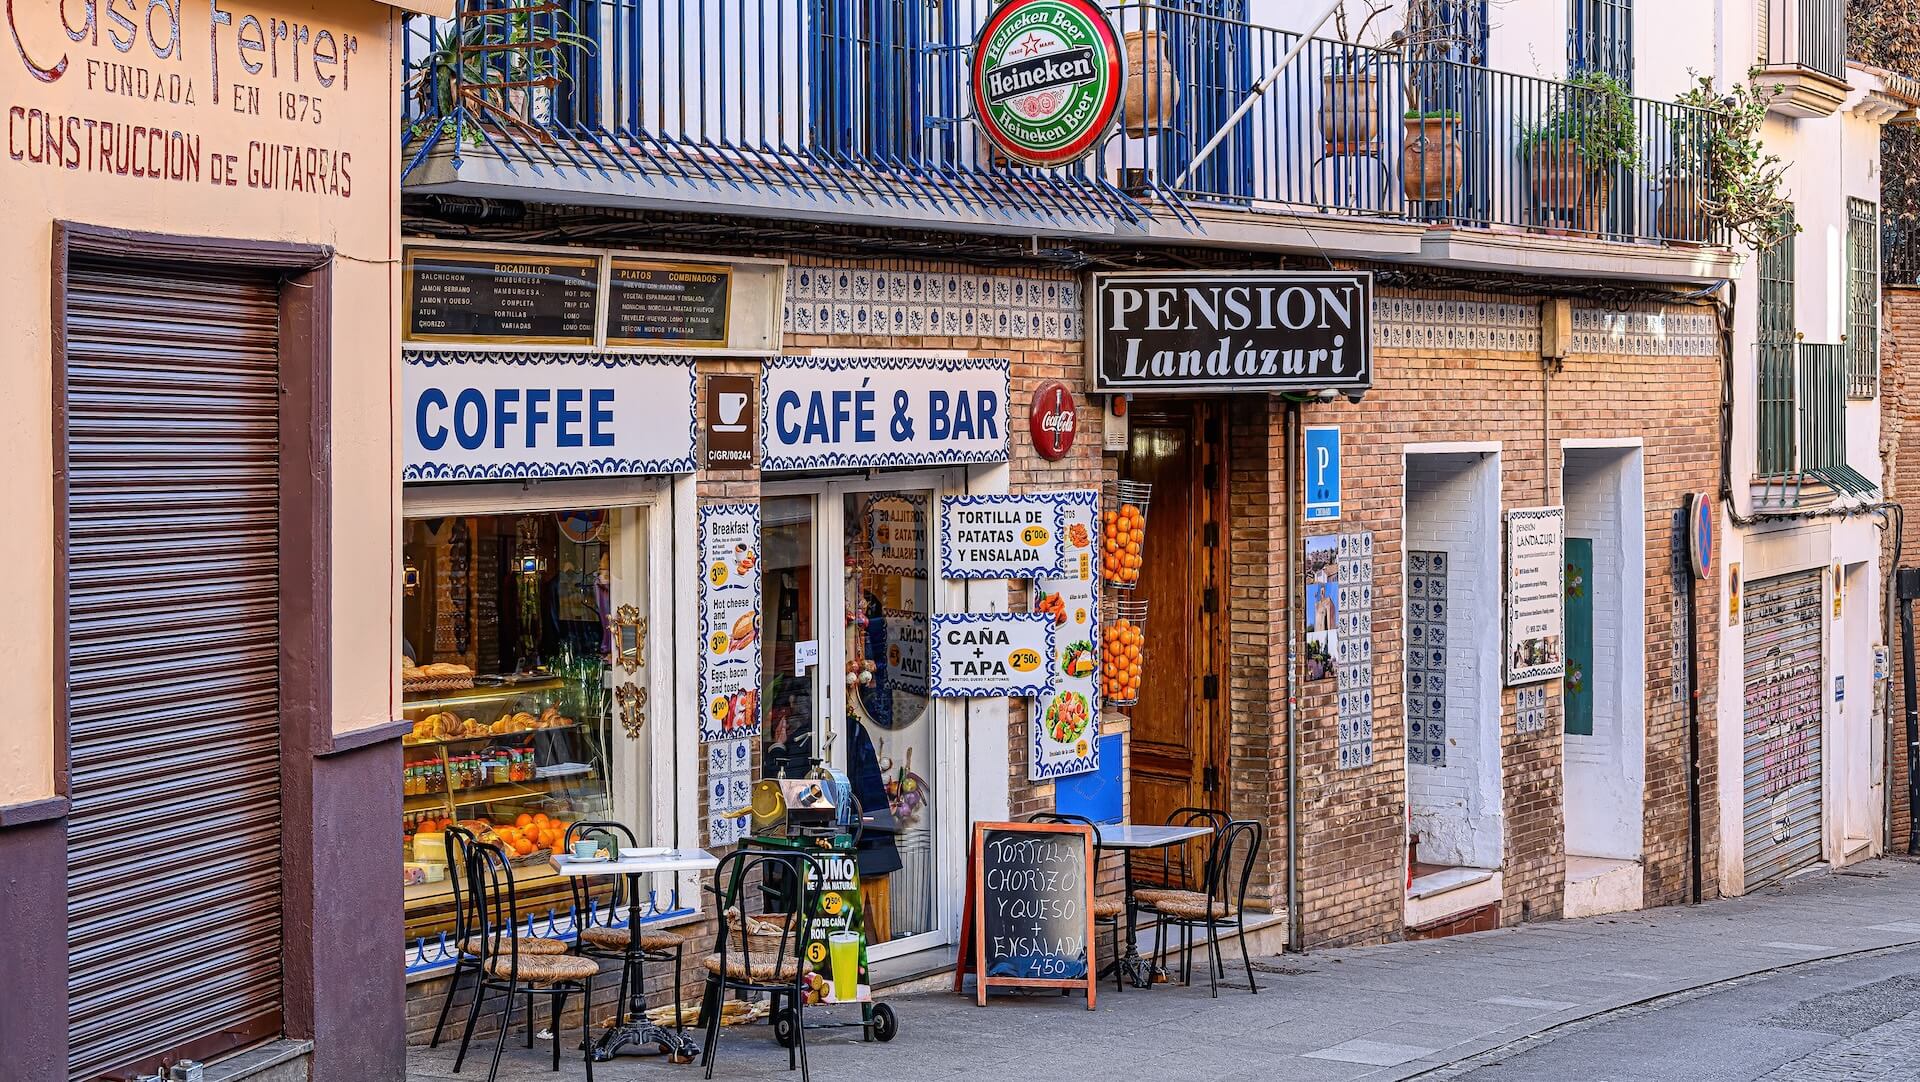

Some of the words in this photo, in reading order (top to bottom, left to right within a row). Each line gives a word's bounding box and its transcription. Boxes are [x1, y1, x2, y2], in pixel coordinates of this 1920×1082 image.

[988, 11, 1049, 60] Heineken
[1051, 10, 1085, 41] Beer
[989, 58, 1091, 98] Heineken
[86, 58, 196, 106] FUNDADA
[234, 84, 260, 116] EN
[278, 91, 323, 125] 1875
[999, 110, 1067, 142] Heineken
[1061, 90, 1093, 131] Beer
[9, 105, 200, 183] CONSTRUCCION
[248, 140, 352, 198] GUITARRAS
[494, 264, 551, 275] BOCADILLOS
[621, 270, 652, 280] PLATOS
[668, 273, 717, 283] COMBINADOS
[501, 299, 535, 307] COMPLETA
[1108, 286, 1354, 331] PENSION
[419, 308, 436, 316] ATUN
[494, 310, 527, 319] TORTILLAS
[564, 312, 580, 320] LOMO
[418, 320, 446, 328] CHORIZO
[501, 322, 532, 330] VARIADAS
[563, 323, 578, 331] LOMO
[1122, 334, 1345, 378] Landázuri
[775, 377, 876, 445] CAFÉ
[890, 389, 915, 442] &
[929, 390, 999, 440] BAR
[416, 387, 615, 451] COFFEE
[708, 450, 752, 461] C/GR/00244
[1316, 446, 1329, 486] P
[957, 511, 1021, 524] TORTILLA
[1025, 511, 1042, 524] DE
[712, 520, 749, 536] Breakfast
[958, 530, 1014, 543] PATATAS
[957, 549, 966, 562] Y
[970, 548, 1040, 562] ENSALADA
[713, 599, 725, 610] Hot
[726, 598, 749, 609] cheese
[713, 609, 726, 620] and
[713, 620, 728, 631] ham
[947, 627, 1010, 645] CAÑA
[973, 647, 984, 658] +
[711, 669, 728, 683] Eggs,
[729, 667, 748, 679] bacon
[950, 661, 1007, 676] TAPA
[711, 684, 723, 694] and
[724, 682, 740, 693] toast
[832, 881, 857, 891] NATURAL
[997, 897, 1008, 918] Y
[1010, 898, 1076, 921] QUESO
[821, 918, 830, 927] DE
[830, 916, 846, 927] CAÑA
[811, 928, 826, 940] RON
[993, 935, 1085, 958] ENSALADA
